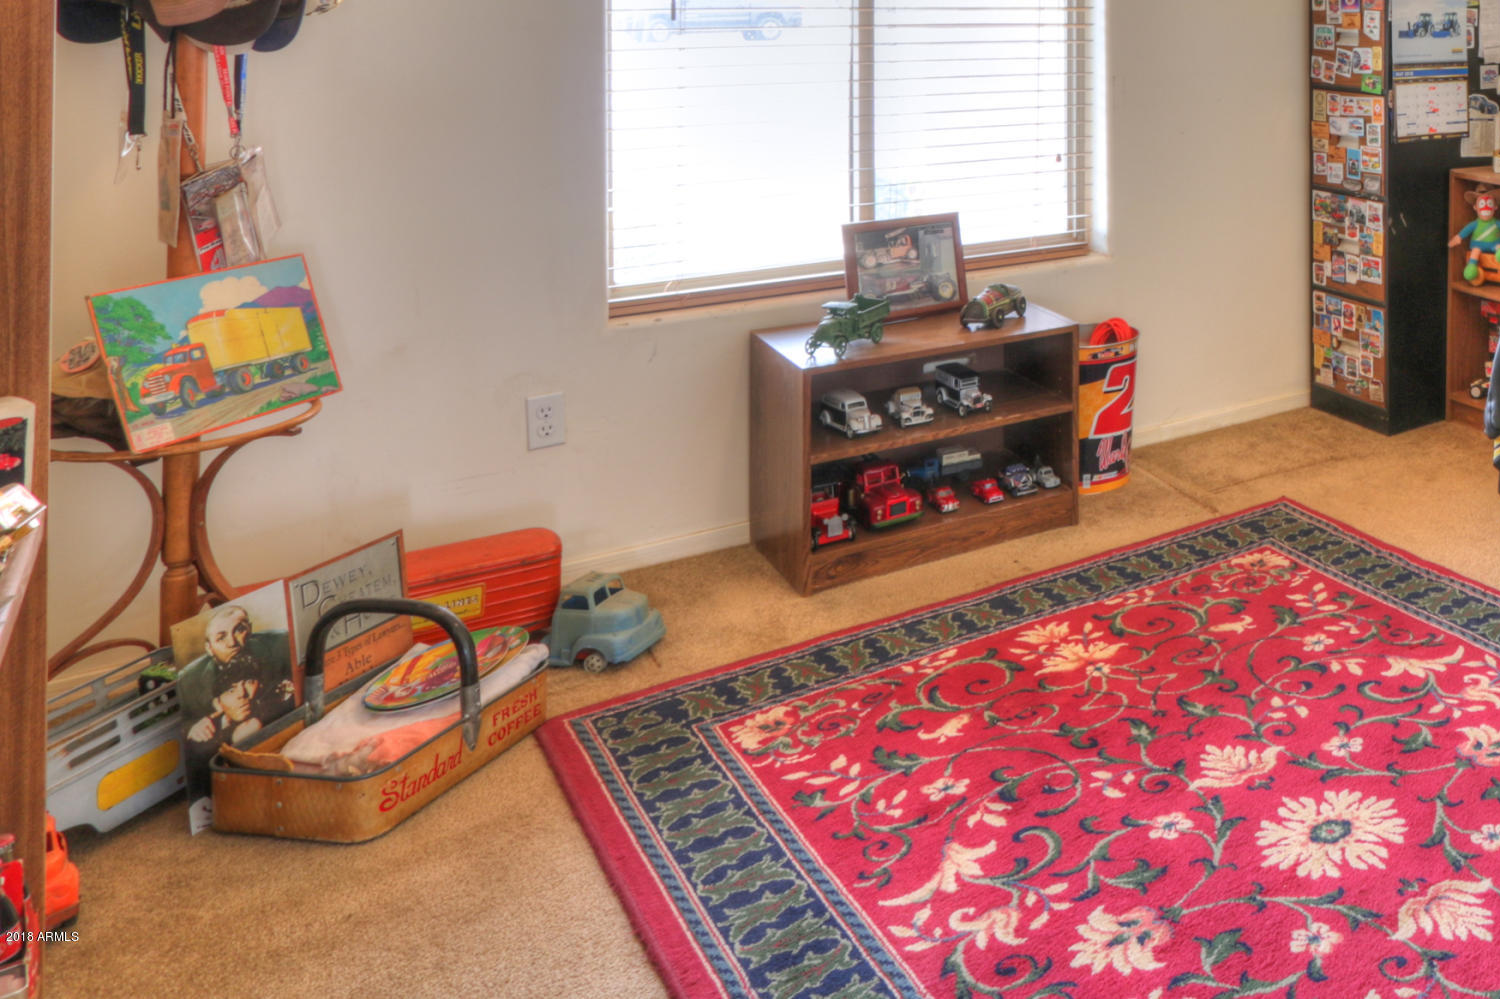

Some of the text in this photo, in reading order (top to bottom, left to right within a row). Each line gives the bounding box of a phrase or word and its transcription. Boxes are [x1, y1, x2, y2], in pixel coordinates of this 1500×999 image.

[1088, 355, 1138, 440] 2
[345, 653, 373, 676] Able
[487, 703, 542, 748] COFFEE
[492, 688, 538, 728] FRESH
[378, 733, 464, 813] Standard
